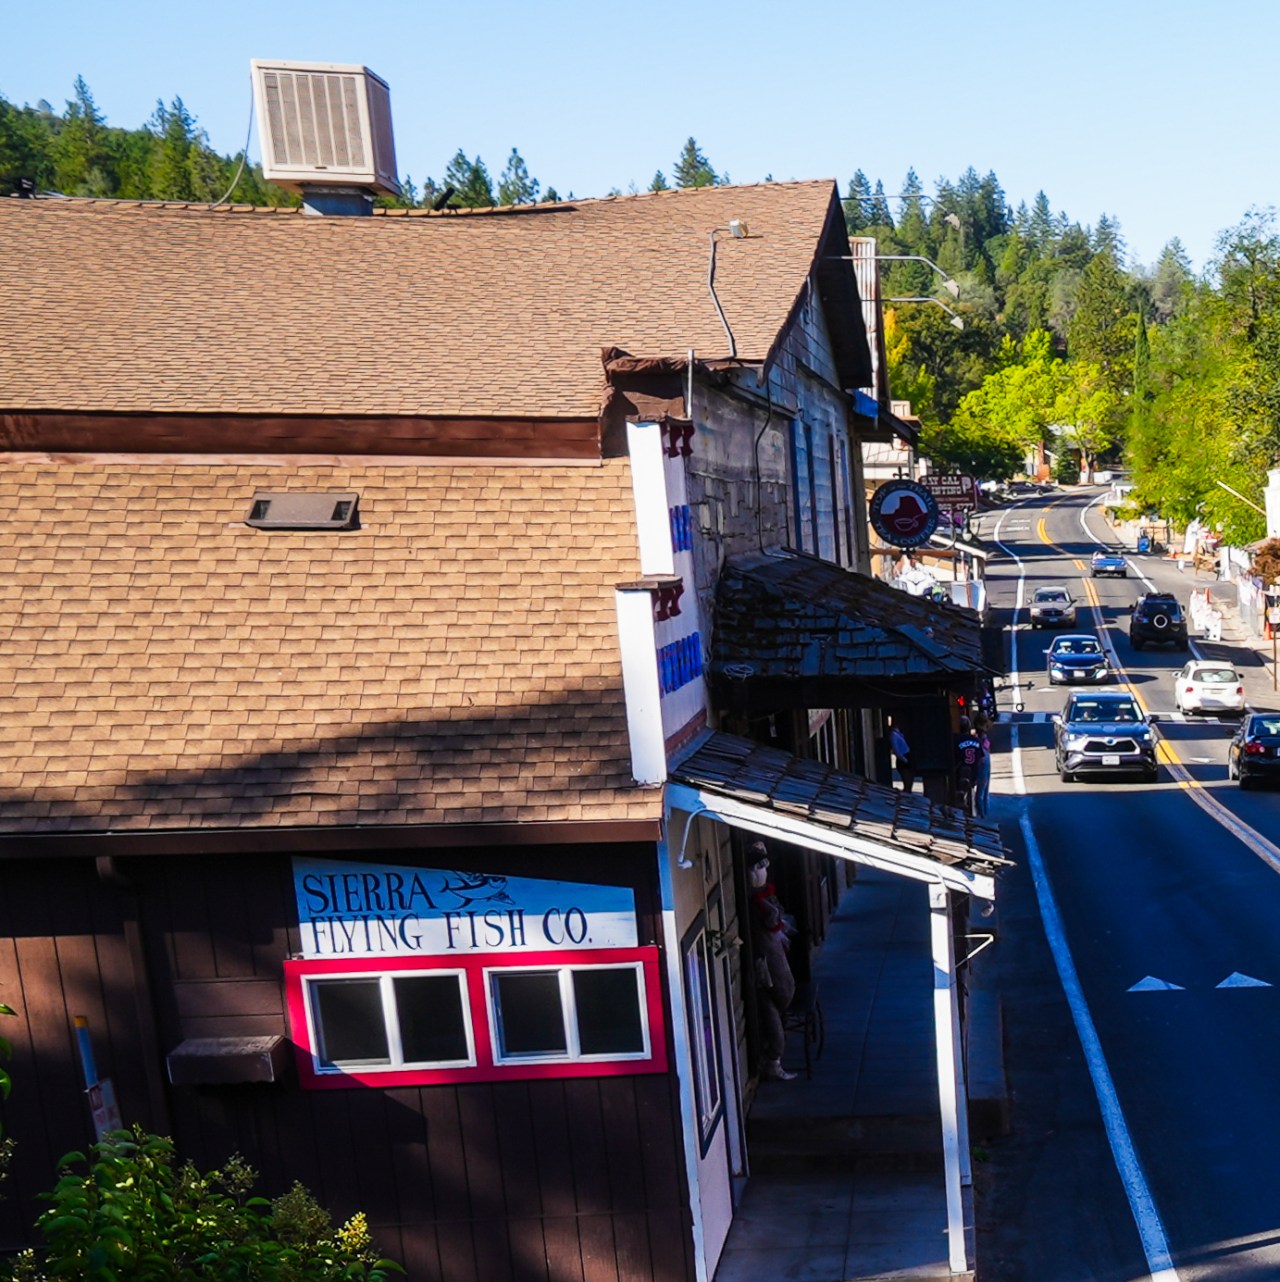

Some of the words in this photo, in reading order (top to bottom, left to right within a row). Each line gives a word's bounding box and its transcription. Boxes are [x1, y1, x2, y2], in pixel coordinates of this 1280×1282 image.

[875, 520, 891, 541] TEA
[898, 518, 936, 545] COFFEE
[964, 748, 975, 764] 5
[303, 872, 437, 914] SIERRA
[308, 913, 424, 955] FLYING
[443, 908, 527, 949] FISH
[543, 906, 593, 945] CO.
